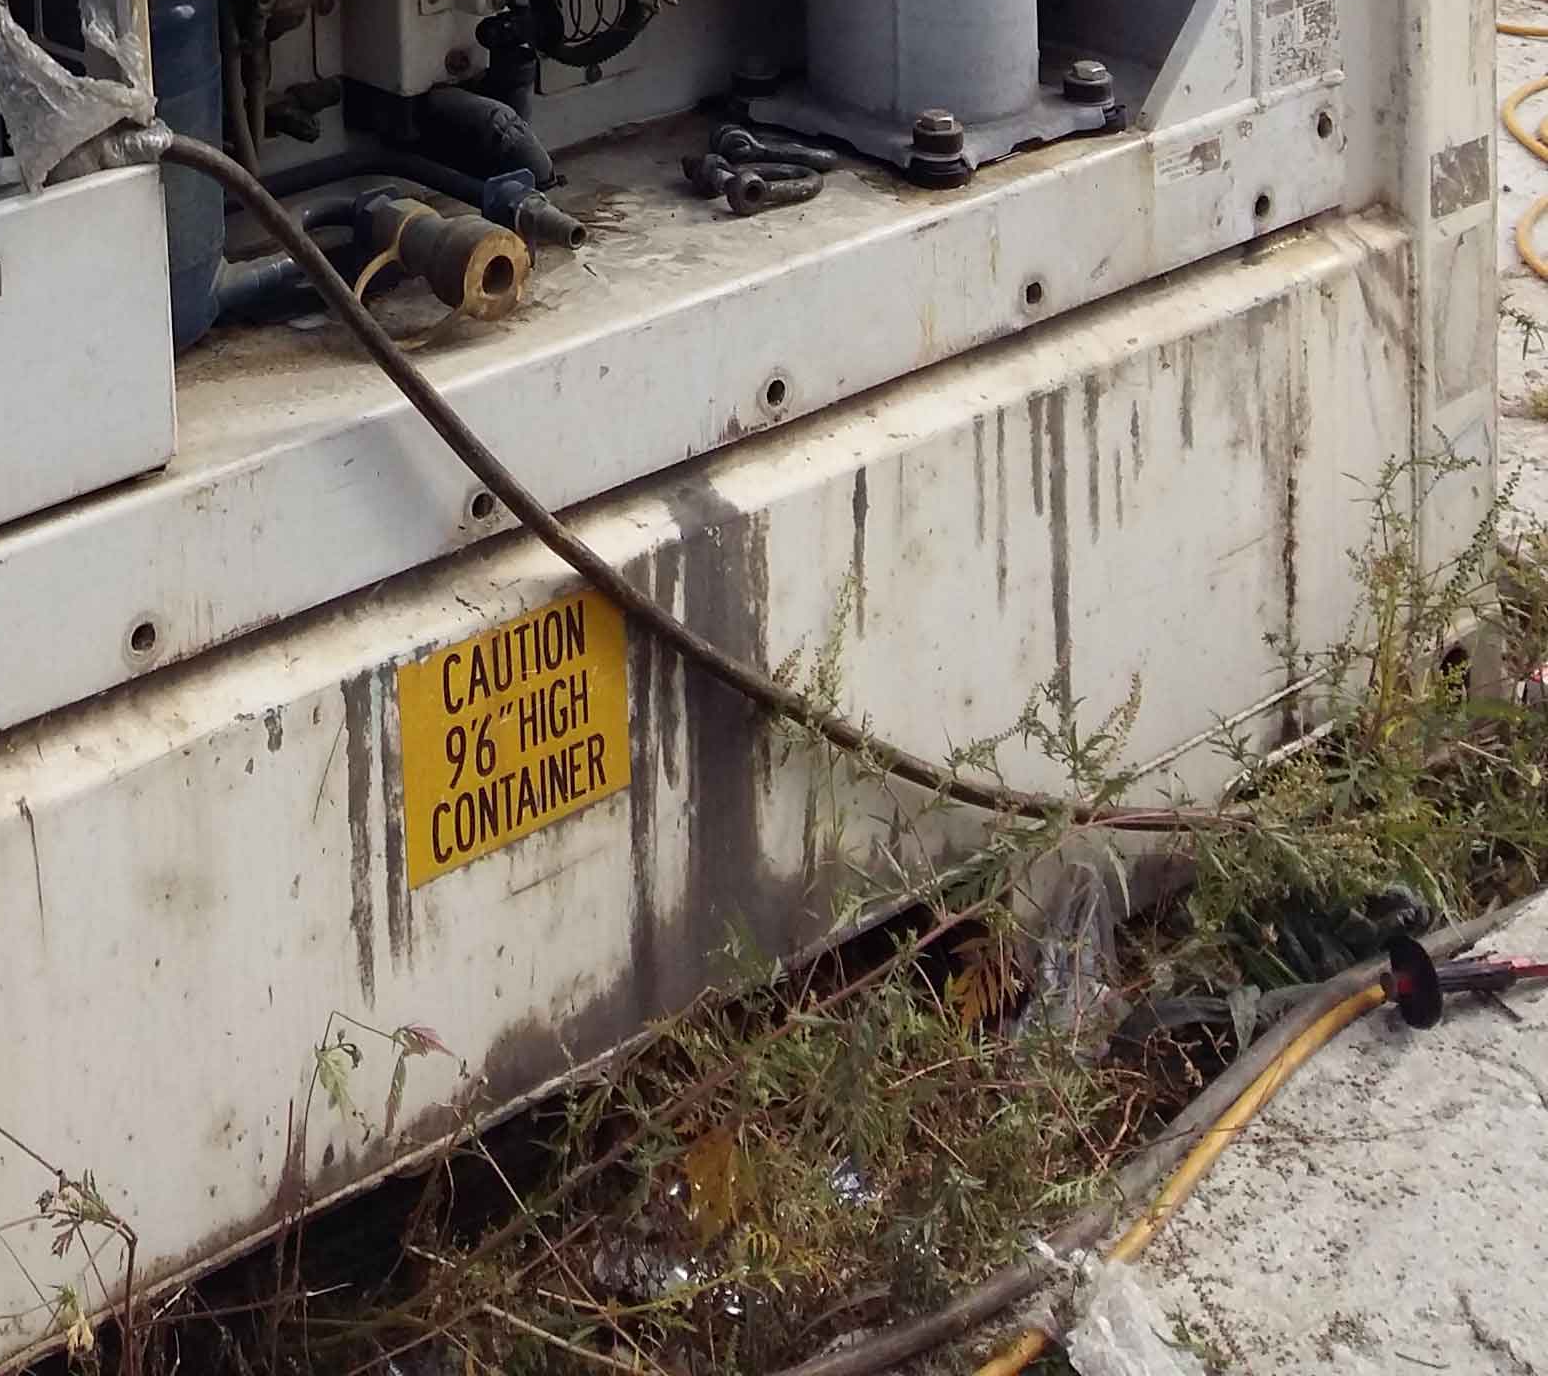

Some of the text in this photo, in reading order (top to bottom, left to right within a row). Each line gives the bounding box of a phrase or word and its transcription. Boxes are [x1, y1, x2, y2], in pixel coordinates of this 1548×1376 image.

[442, 599, 586, 715] CAUTION
[519, 669, 589, 753] HIGH
[432, 732, 607, 864] CONTAINER
